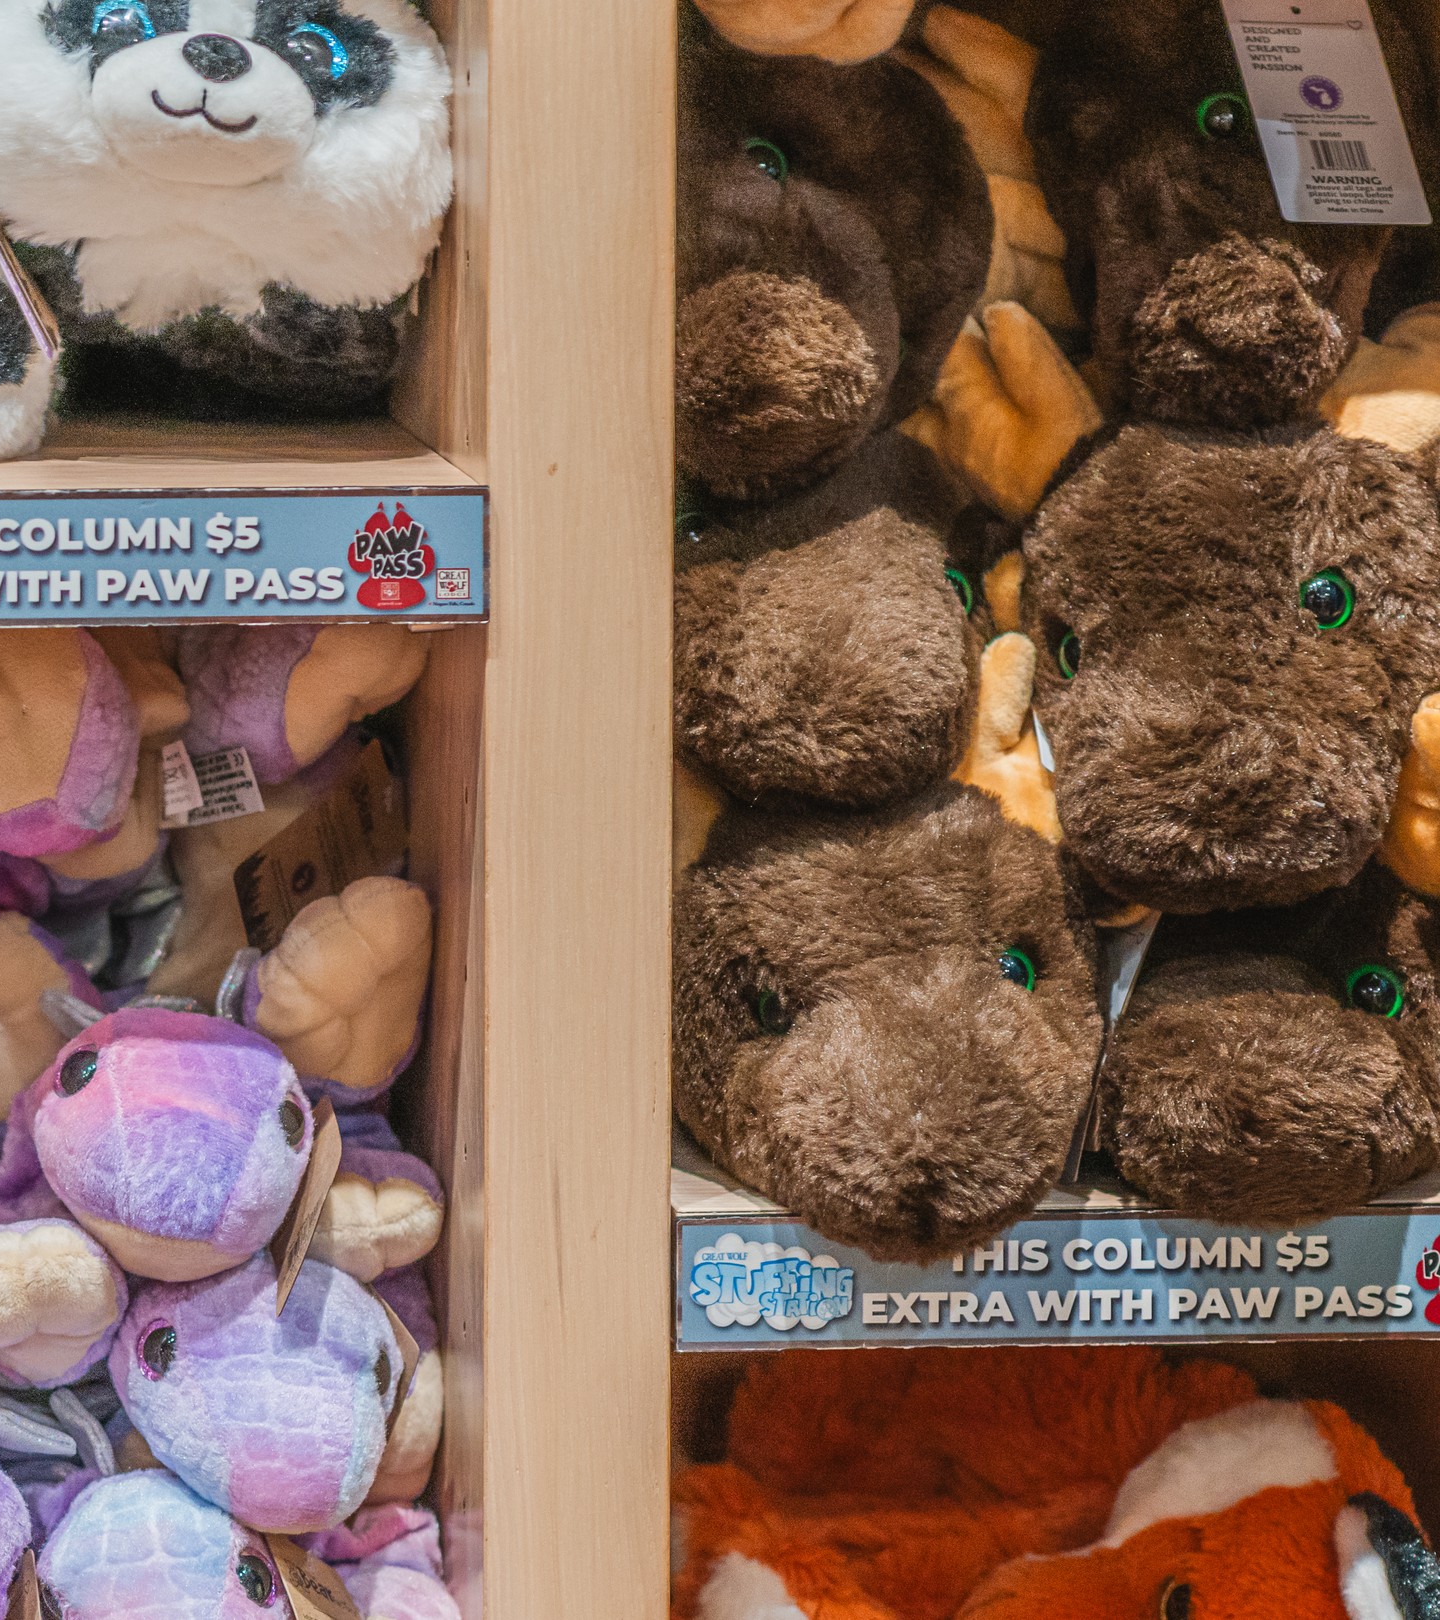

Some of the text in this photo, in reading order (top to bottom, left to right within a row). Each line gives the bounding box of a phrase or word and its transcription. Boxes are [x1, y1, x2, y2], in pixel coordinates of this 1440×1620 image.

[1242, 26, 1302, 36] DESIGNED
[1245, 36, 1271, 44] AND
[1247, 45, 1301, 54] CREATED
[1250, 54, 1283, 62] WITH
[1252, 63, 1303, 72] PASSION
[1311, 175, 1383, 185] WARNING
[1365, 190, 1394, 199] before
[205, 512, 261, 554] $5
[355, 521, 424, 562] PAW
[372, 550, 425, 579] PASS
[438, 570, 468, 580] GREAT
[96, 568, 210, 602] PAW
[224, 566, 346, 601] PASS
[701, 1251, 749, 1261] GREAT WOLF
[1063, 1236, 1262, 1271] COLUMN
[1276, 1231, 1330, 1272] $5
[862, 1284, 1413, 1324] EXTRA WITH PAW PASS
